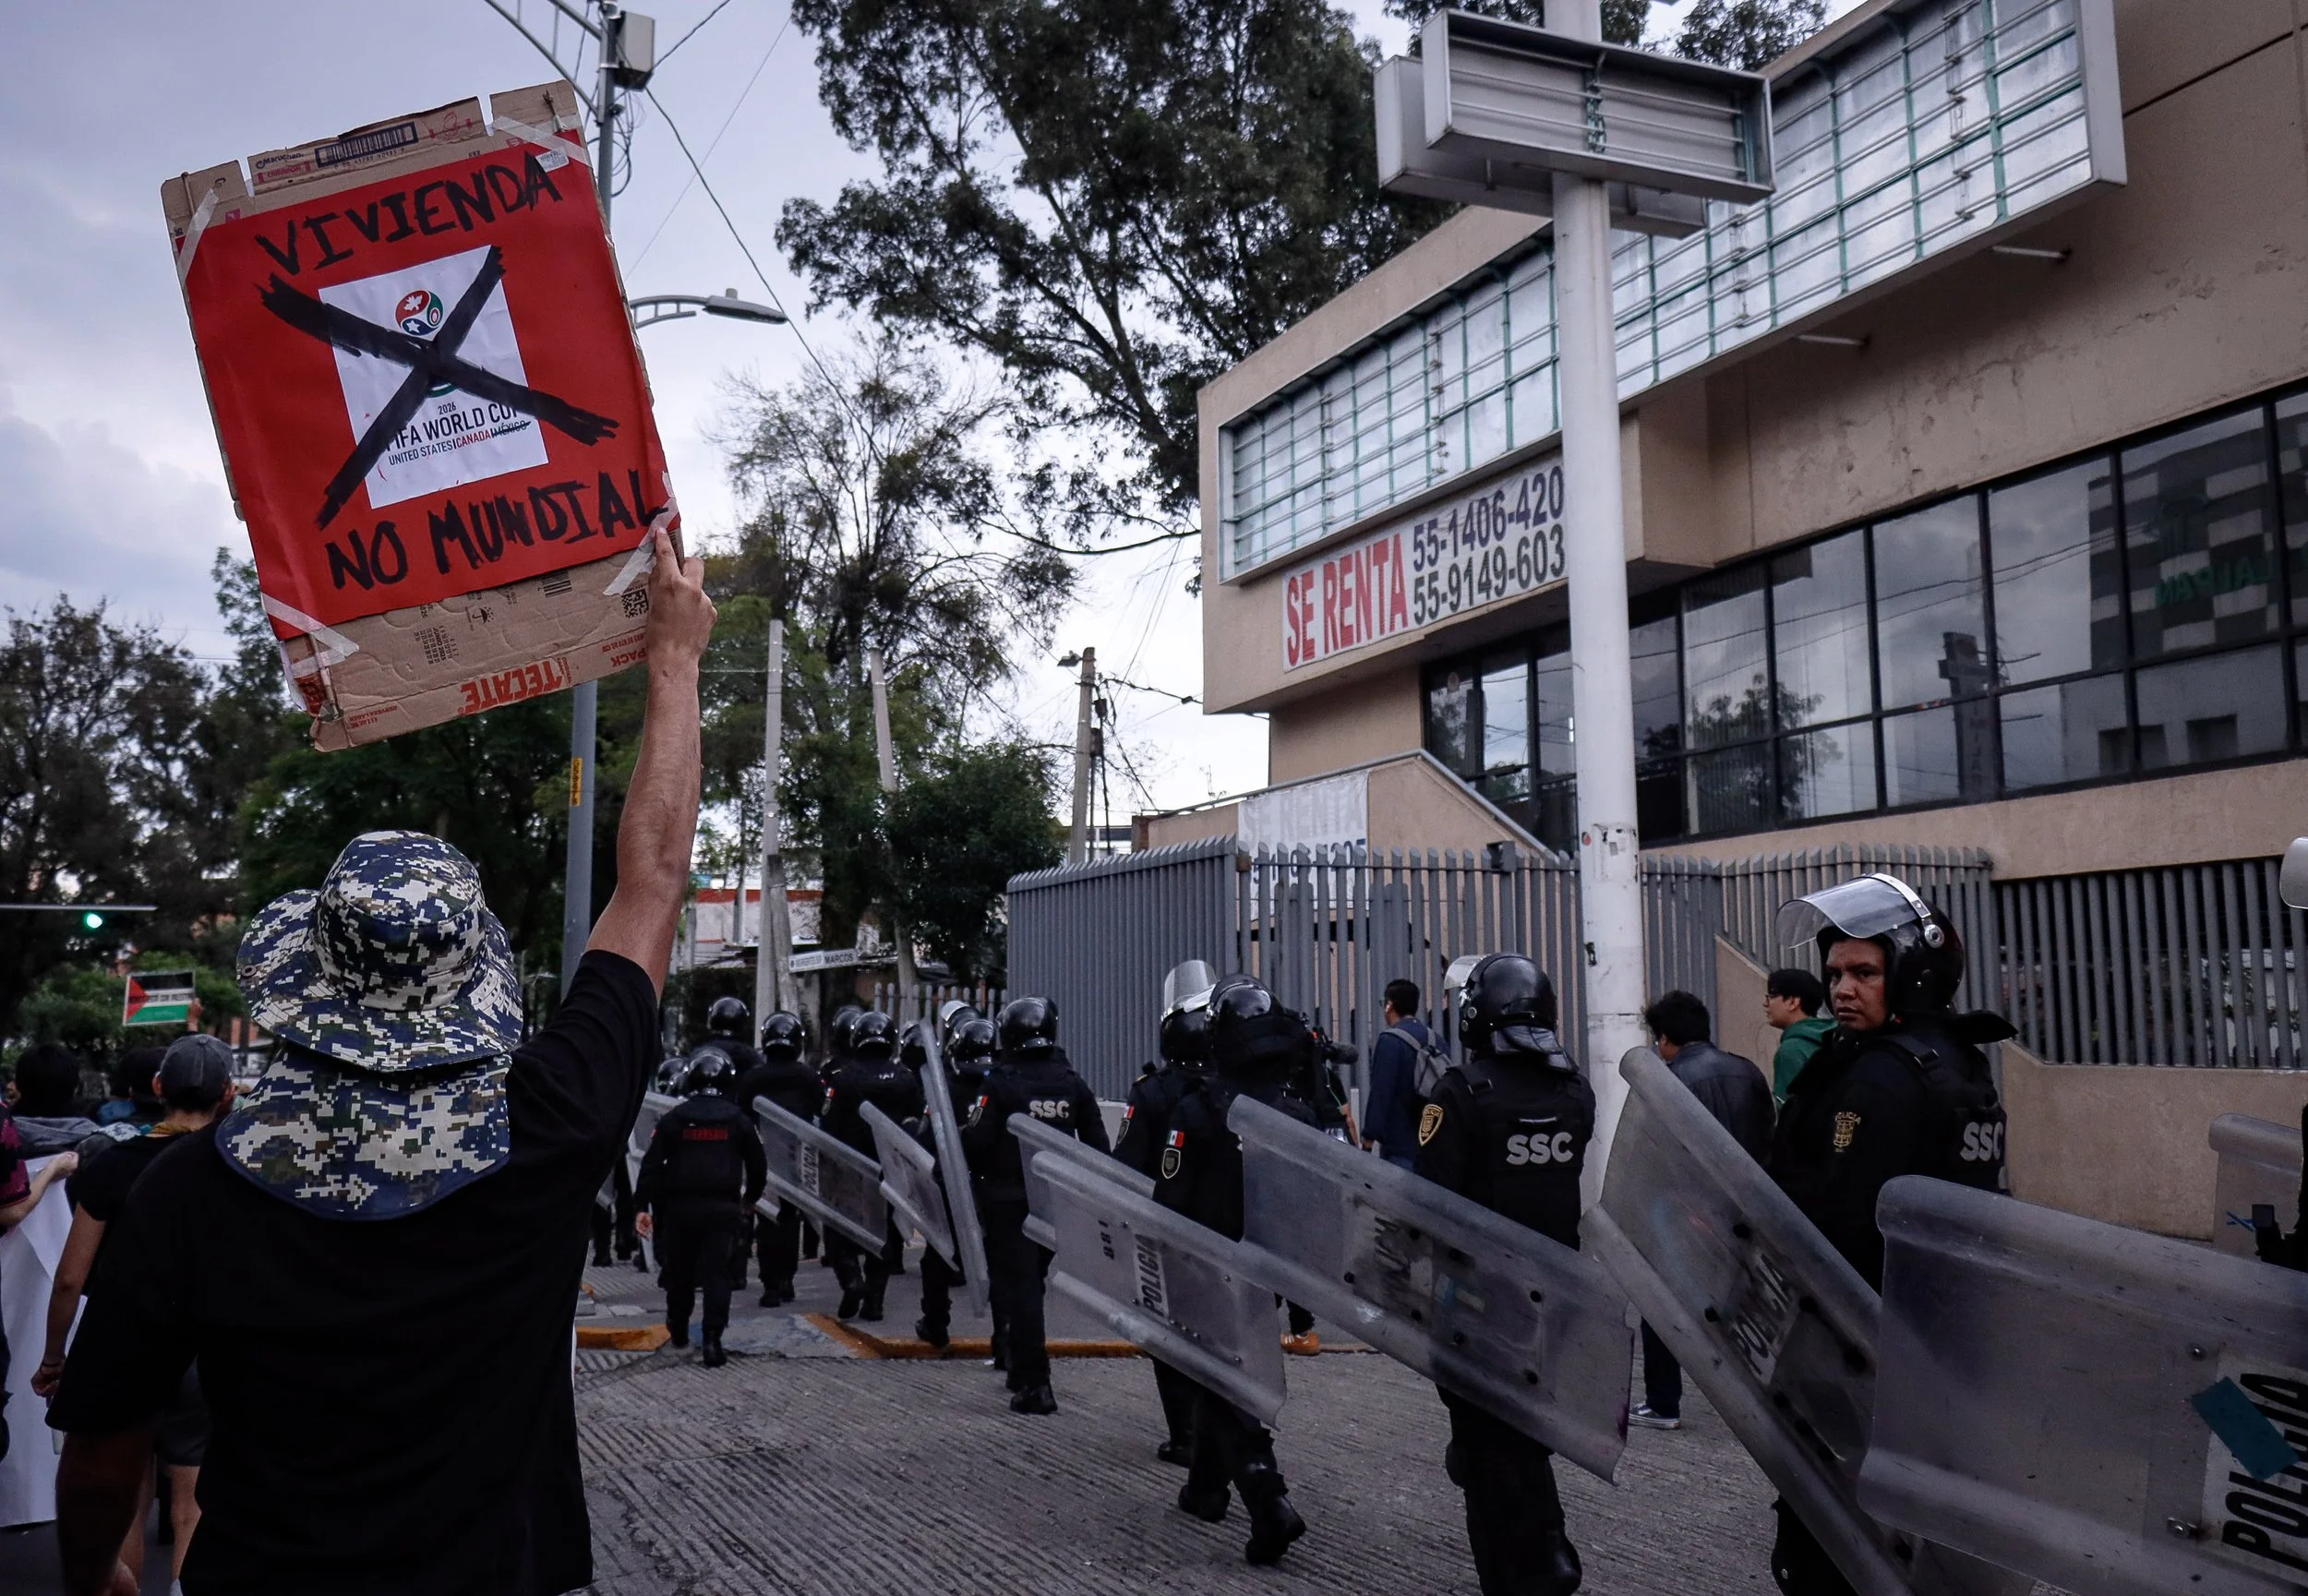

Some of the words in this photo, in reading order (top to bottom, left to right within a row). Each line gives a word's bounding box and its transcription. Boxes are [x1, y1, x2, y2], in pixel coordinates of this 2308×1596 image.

[255, 152, 563, 276] VIVIENDA
[387, 426, 421, 451] IFA
[423, 407, 485, 441] WORLD
[438, 402, 457, 414] 2026
[388, 449, 418, 465] UNITED
[421, 440, 453, 458] STATES
[456, 431, 490, 450] CANADA
[325, 521, 408, 591] NO
[427, 469, 670, 575] MUNDIAL
[1287, 570, 1316, 666] SE
[1323, 533, 1410, 654] RENTA
[611, 647, 647, 667] PACK
[461, 657, 562, 714] TECATE
[1028, 1100, 1070, 1119] SSC
[1506, 1133, 1572, 1166] SSC
[1960, 1121, 2005, 1161] SSC
[1135, 1234, 1165, 1317] POLICIA
